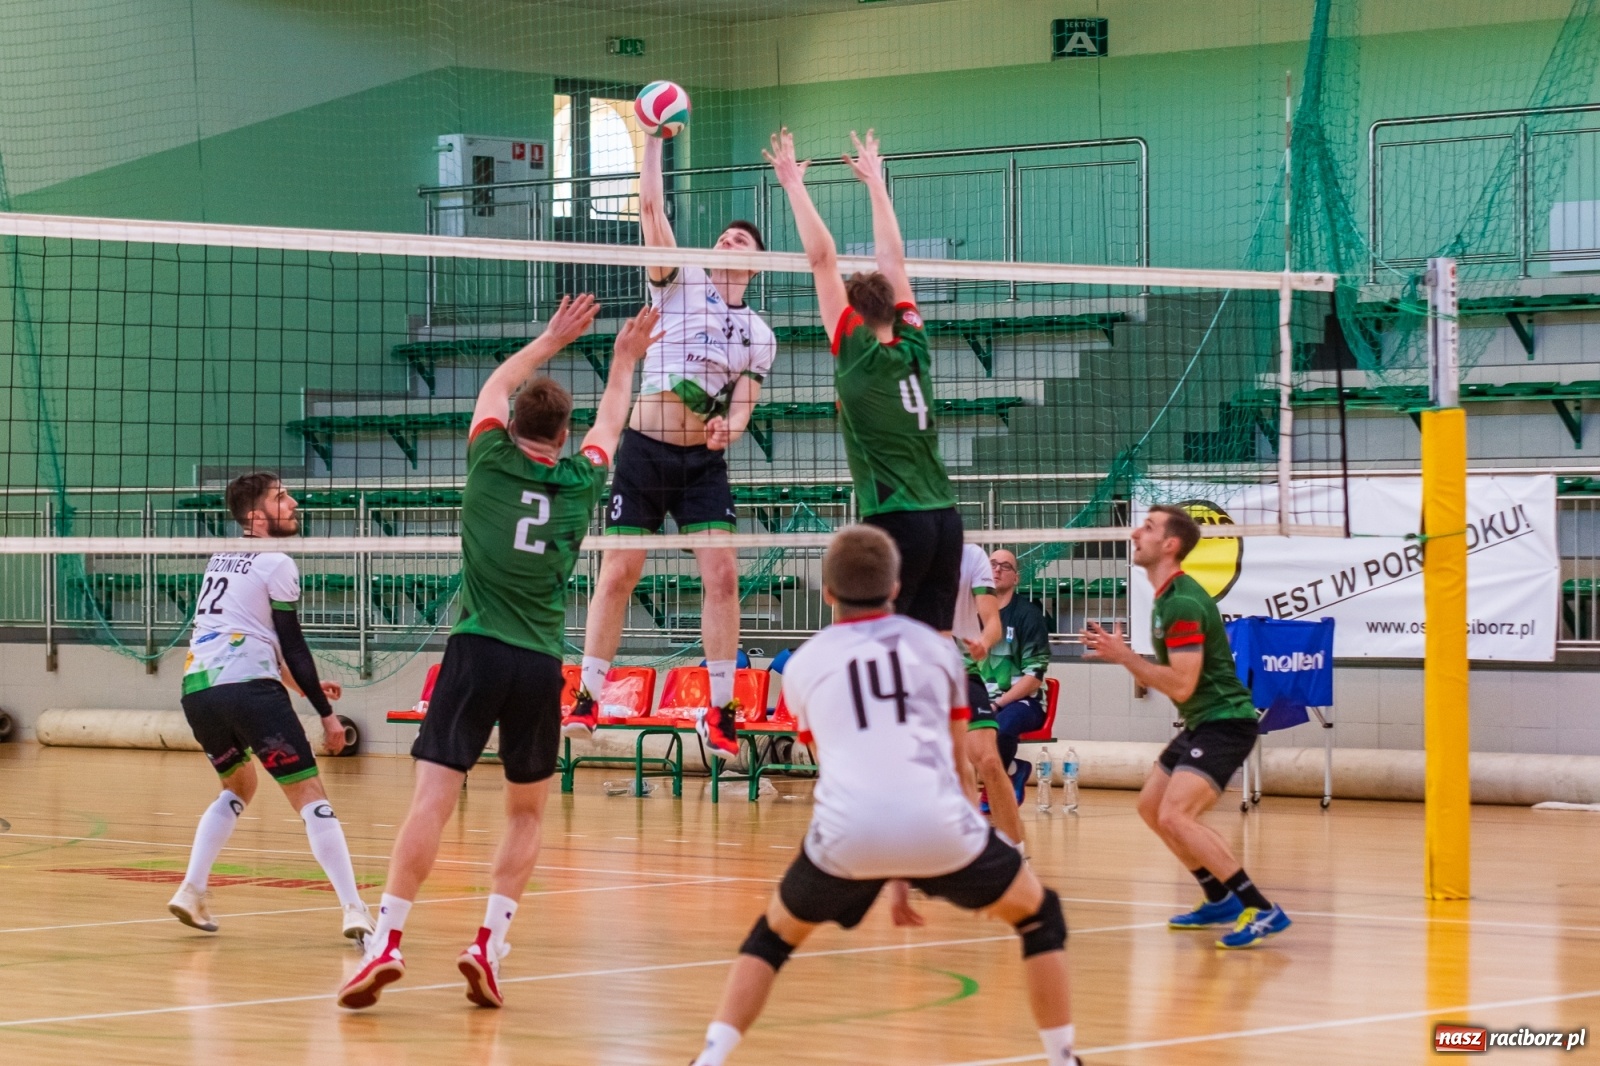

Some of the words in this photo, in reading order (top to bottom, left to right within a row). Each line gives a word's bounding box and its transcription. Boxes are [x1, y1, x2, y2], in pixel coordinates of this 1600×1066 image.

[1062, 31, 1098, 53] A
[899, 374, 929, 430] 4
[513, 490, 550, 555] 2
[610, 494, 623, 521] 3
[1265, 579, 1323, 619] JEST
[1331, 566, 1356, 598] W
[1363, 503, 1531, 587] PORDKU!
[197, 576, 229, 616] 22
[1261, 651, 1323, 672] molten
[849, 650, 909, 729] 14
